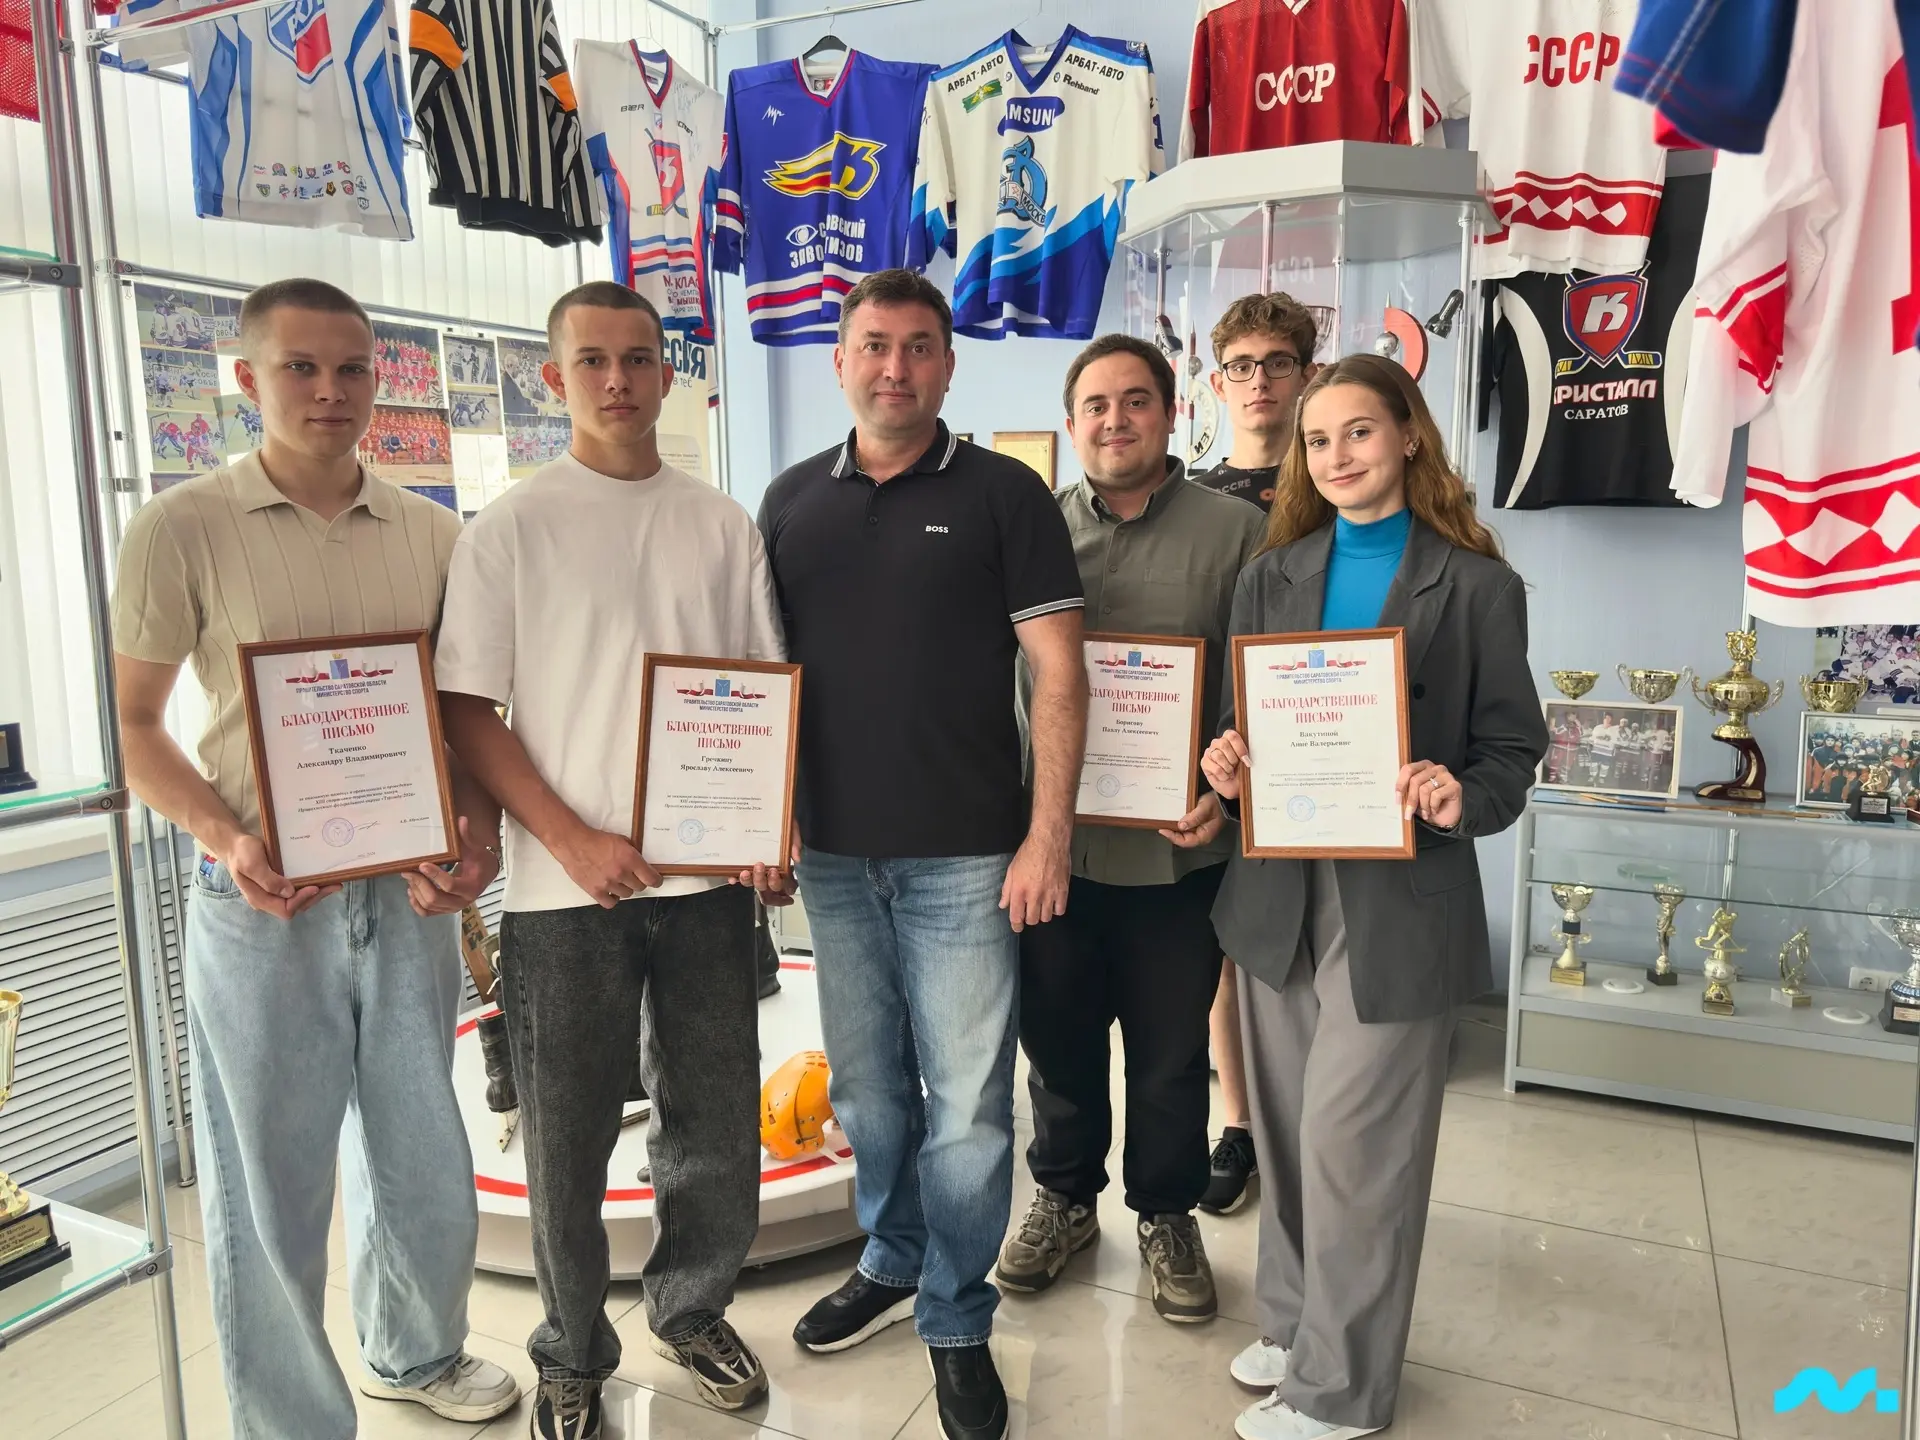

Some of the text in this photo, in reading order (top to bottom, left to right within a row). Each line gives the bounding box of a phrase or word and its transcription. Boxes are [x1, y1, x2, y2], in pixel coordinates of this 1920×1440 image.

[1063, 73, 1099, 95] Rehband
[1255, 62, 1336, 111] СССР
[1005, 103, 1056, 126] MSUN
[1023, 195, 1046, 224] МОСКВ
[1564, 404, 1629, 420] САРАТОВ
[925, 525, 949, 534] BOSS
[1089, 688, 1180, 703] ЛАГОДАРСТВЕННОЕ
[1261, 694, 1378, 711] БЛАГОДАРСТВЕННОЕ
[281, 702, 410, 727] БЛАГОДАРСТВЕННОЕ
[1112, 703, 1151, 714] ПИСЬМО
[1295, 711, 1344, 724] ПИСЬМО
[322, 723, 375, 740] ПИСЬМО
[666, 720, 773, 737] БЛАГОДАРСТВЕННОЕ
[328, 745, 367, 755] Ткаченко
[697, 737, 741, 750] ПИСЬМО
[297, 750, 407, 769] Александру Владимировичу
